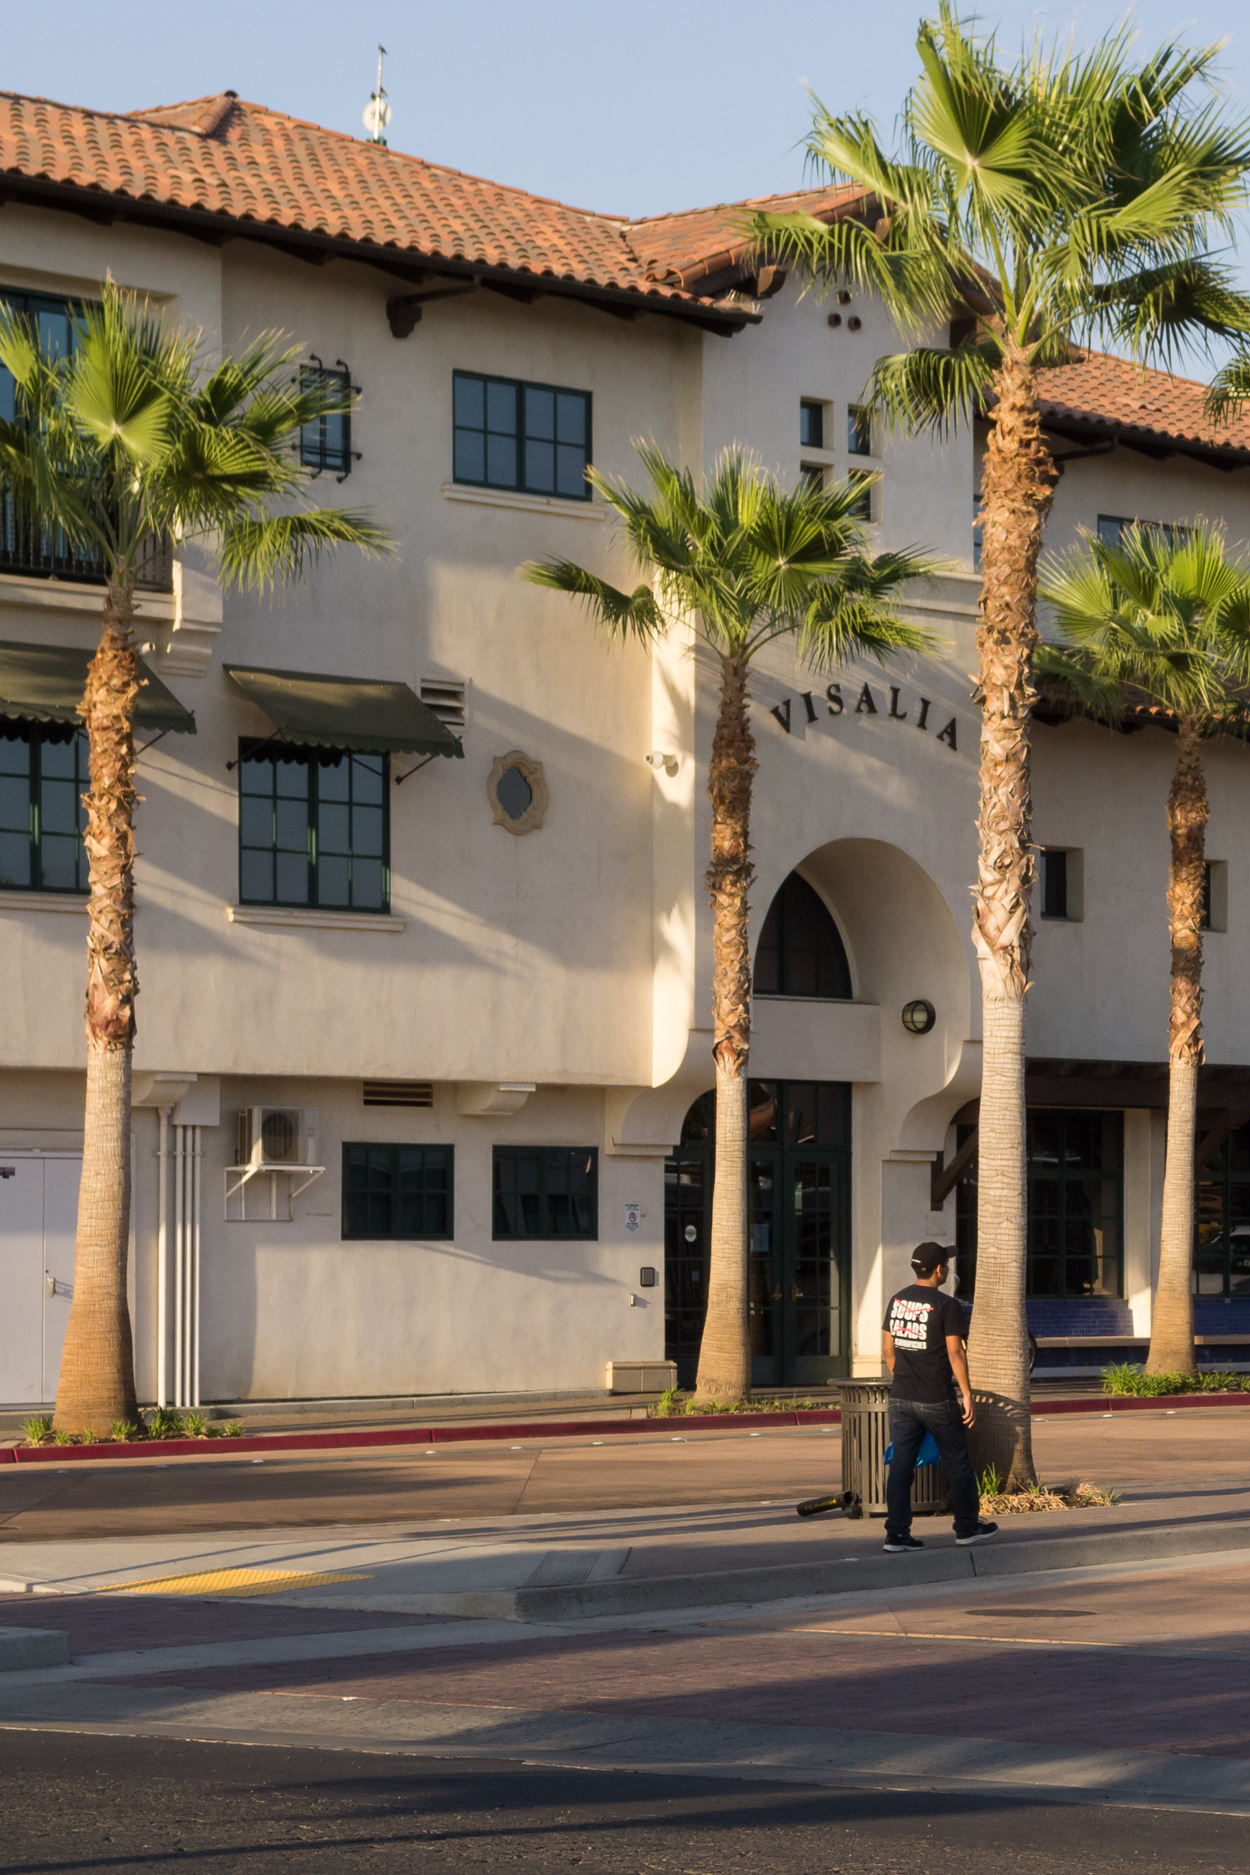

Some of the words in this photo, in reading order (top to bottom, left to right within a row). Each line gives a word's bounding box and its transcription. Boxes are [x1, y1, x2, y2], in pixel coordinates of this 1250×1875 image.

[770, 682, 957, 751] VISALIA
[890, 1299, 931, 1323] SOUPS
[889, 1319, 927, 1340] SALADS
